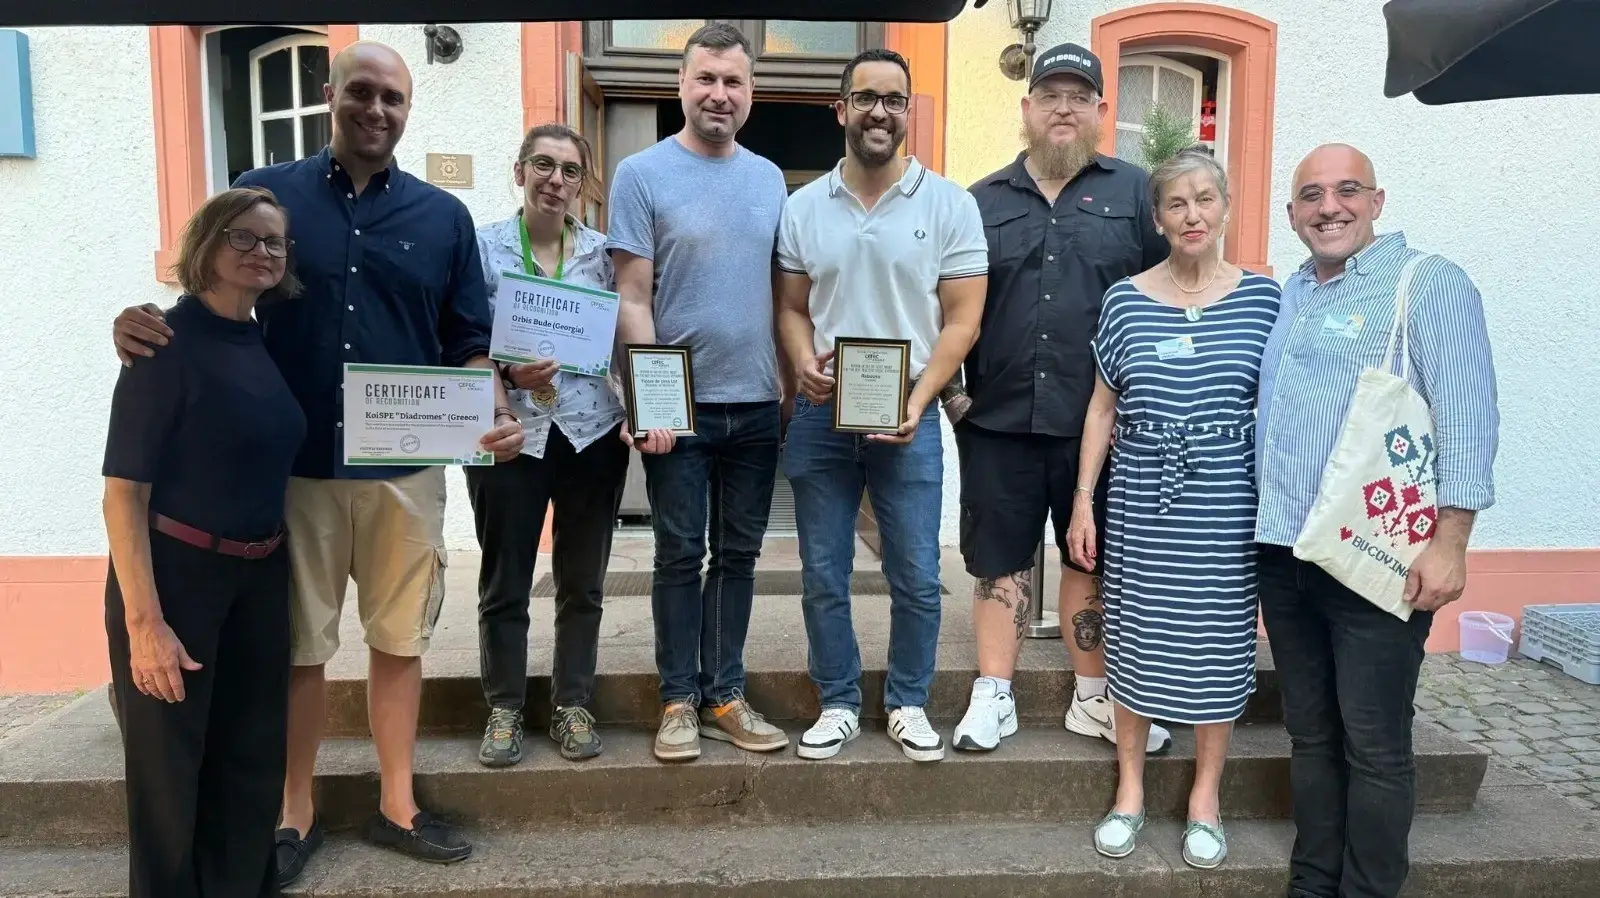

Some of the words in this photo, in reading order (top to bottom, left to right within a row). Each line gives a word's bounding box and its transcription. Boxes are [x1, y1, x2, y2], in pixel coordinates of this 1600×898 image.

[513, 302, 521, 310] OF
[522, 303, 559, 317] RECOGNITION
[514, 290, 581, 314] CERTIFICATE
[512, 314, 532, 325] Orbis
[533, 318, 552, 328] Bude
[552, 321, 585, 335] (Georgia)
[365, 383, 446, 400] CERTIFICATE
[376, 398, 420, 406] RECOGNITION
[365, 411, 395, 420] KoiSPE
[447, 414, 480, 423] (Greece)
[1352, 535, 1410, 580] BUCOVINA
